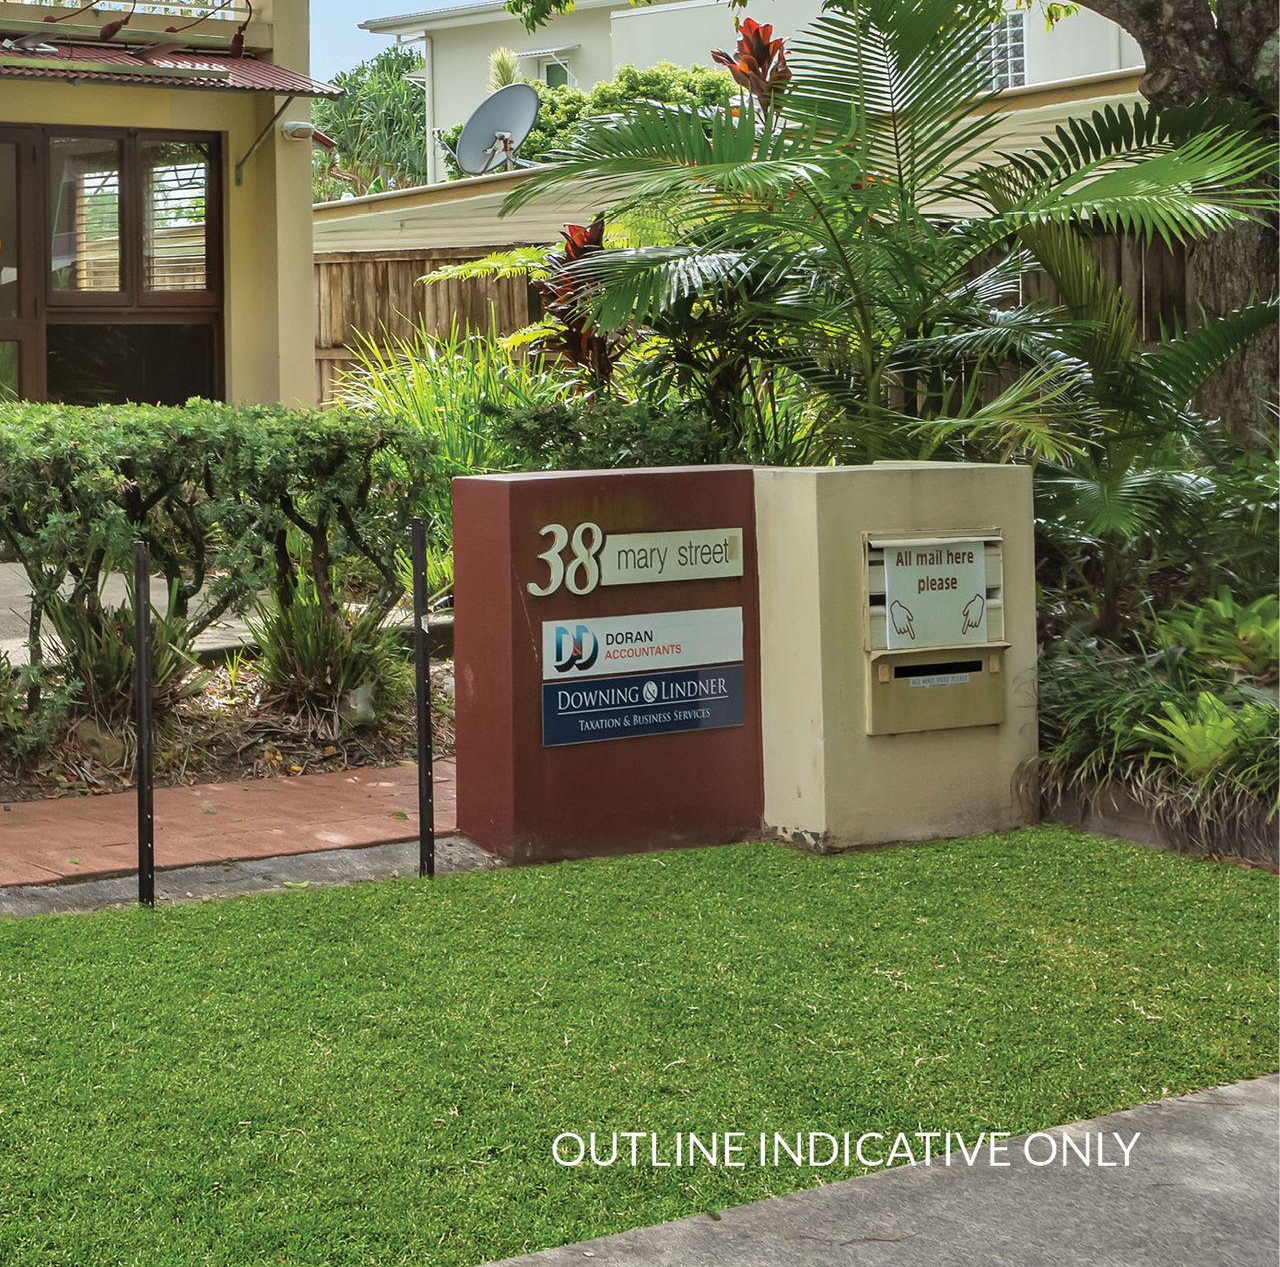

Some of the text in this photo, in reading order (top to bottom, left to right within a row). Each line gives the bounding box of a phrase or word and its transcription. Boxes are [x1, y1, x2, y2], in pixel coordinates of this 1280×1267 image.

[527, 522, 729, 596] 38 mary street
[896, 550, 974, 566] All mail here
[917, 576, 958, 594] please
[605, 629, 654, 645] DORAN
[605, 643, 682, 660] ACCOUNTANTS
[557, 678, 728, 710] DOWNING & LINDNER
[579, 708, 711, 731] TAXATION & BUSINESS SERVICES
